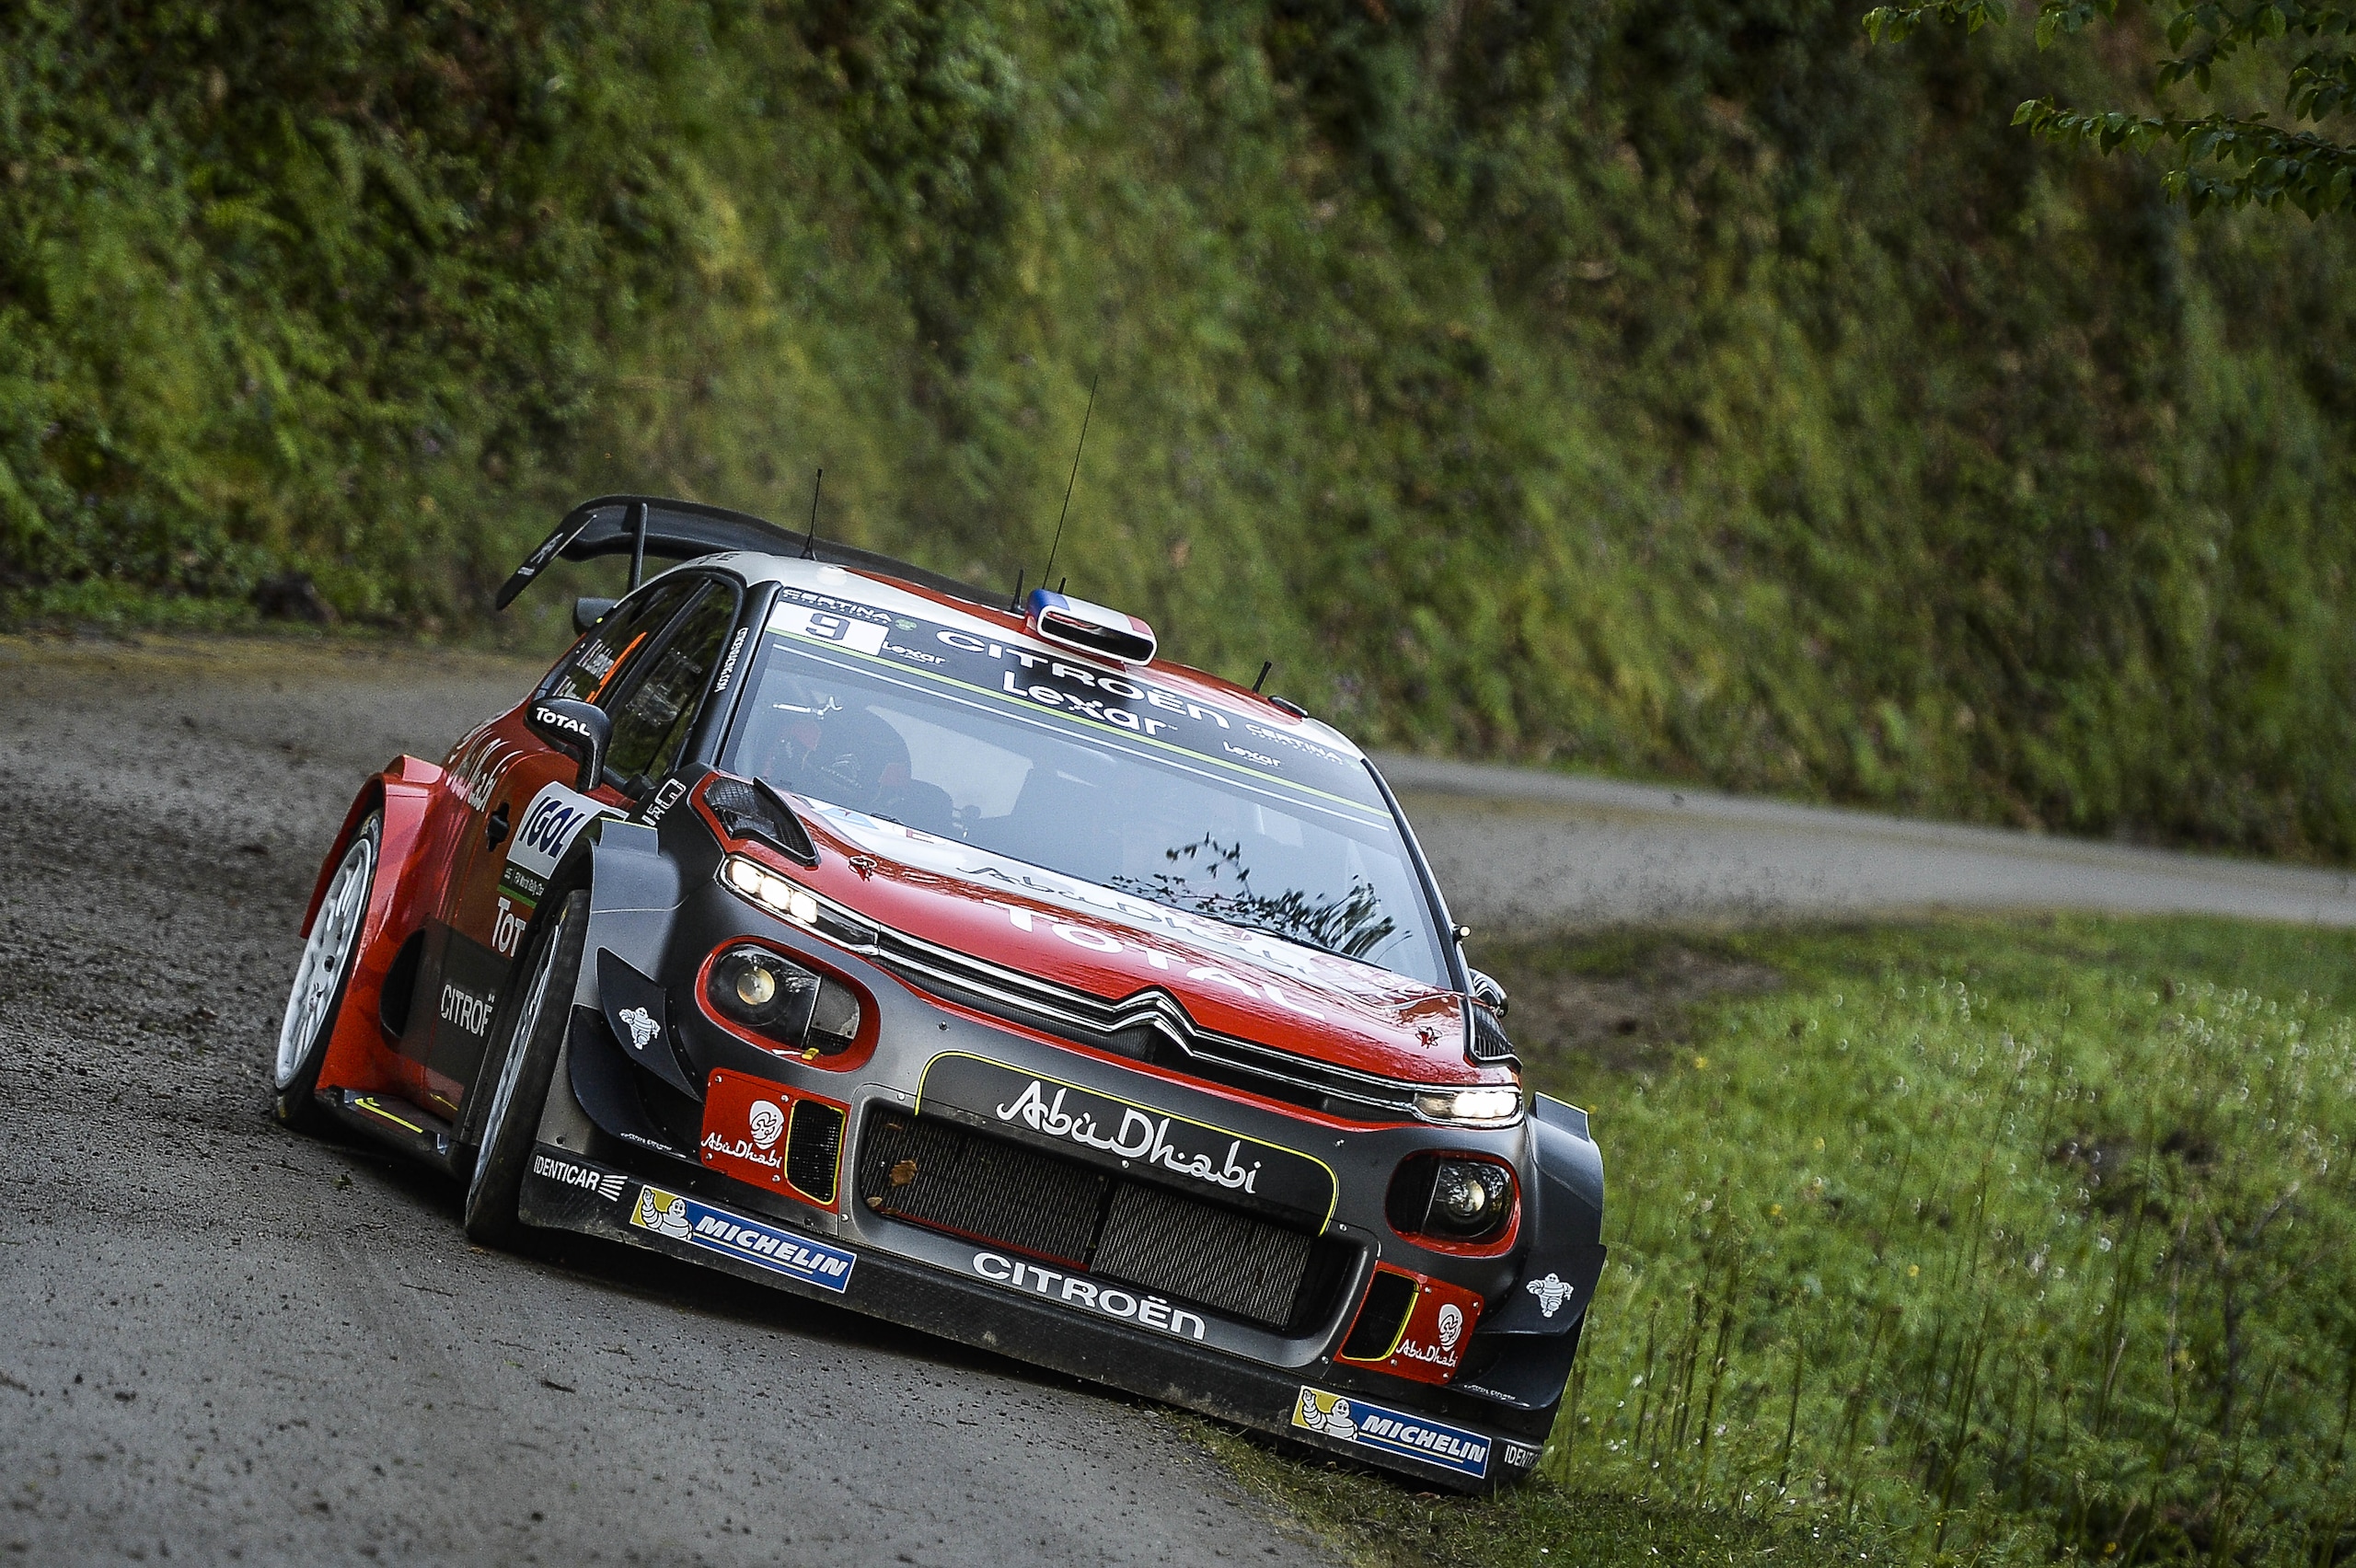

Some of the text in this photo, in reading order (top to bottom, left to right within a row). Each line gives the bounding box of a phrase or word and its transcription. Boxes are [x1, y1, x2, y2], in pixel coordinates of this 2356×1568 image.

[783, 589, 893, 623] CERTINA
[805, 612, 850, 640] 9
[882, 640, 946, 664] Lexar
[537, 707, 591, 736] TOTAL
[1001, 671, 1166, 735] Lexar
[1222, 740, 1282, 767] Lexar
[1245, 723, 1344, 765] CERTINA
[518, 795, 585, 859] IGOL
[983, 898, 1326, 1020] TOTAL
[534, 1155, 600, 1192] IDENTICAR
[696, 1215, 849, 1278] MICHELIN
[1360, 1414, 1487, 1464] MICHELIN
